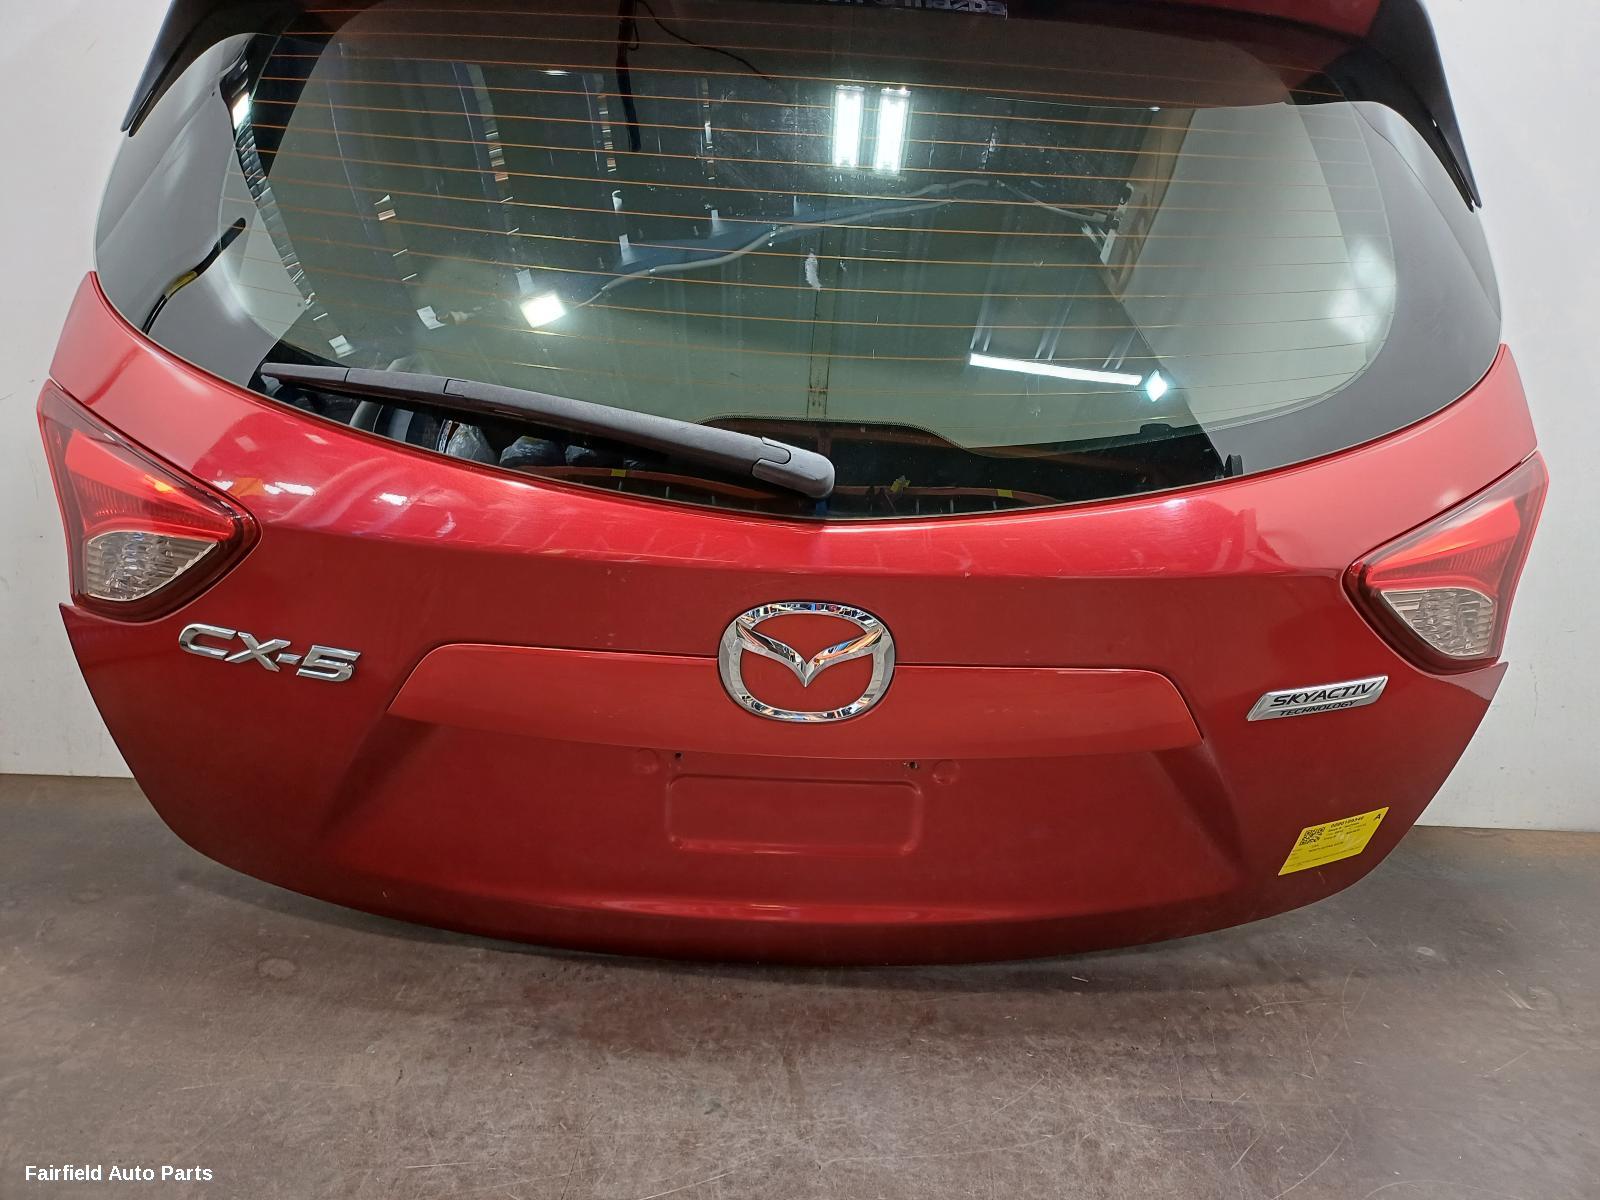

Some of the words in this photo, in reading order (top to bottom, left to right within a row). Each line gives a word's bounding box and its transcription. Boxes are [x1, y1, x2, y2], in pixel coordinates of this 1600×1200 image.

[178, 623, 361, 682] CX-5
[1270, 682, 1377, 707] SKYACTIV
[1280, 699, 1358, 716] TECHNOLOGY
